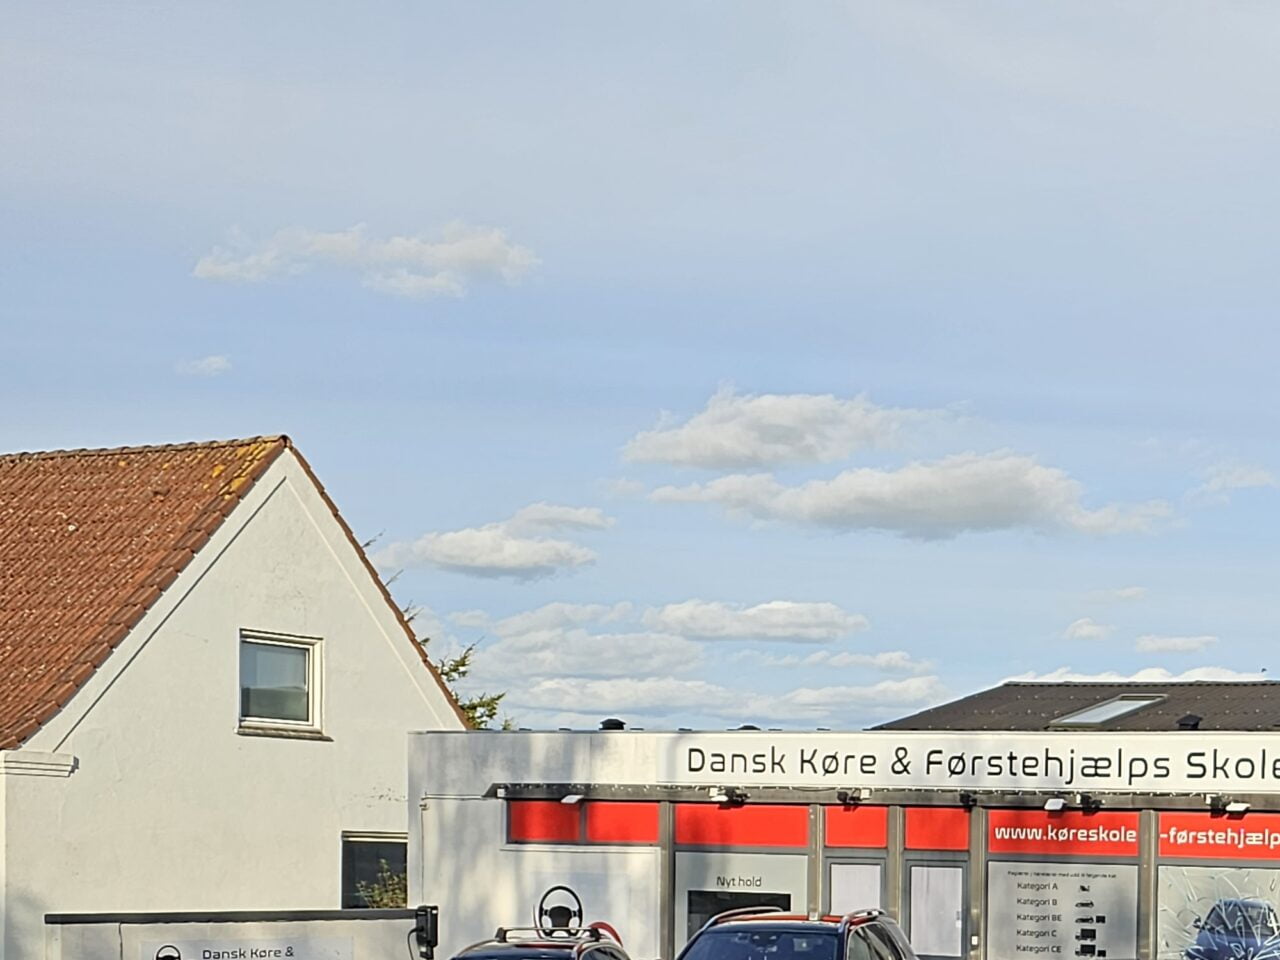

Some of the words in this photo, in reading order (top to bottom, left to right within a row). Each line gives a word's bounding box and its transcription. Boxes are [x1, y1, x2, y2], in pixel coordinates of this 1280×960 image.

[688, 746, 786, 773] Dansk
[800, 749, 877, 777] Køre
[890, 747, 911, 775] &
[926, 748, 1170, 786] Førstehjælps
[994, 825, 1137, 843] www.køreskole
[717, 876, 736, 888] Nyt
[738, 875, 762, 887] hold
[1017, 883, 1050, 891] Kategori
[1017, 898, 1050, 907] Kategori
[1016, 914, 1050, 922] Kategori
[1052, 914, 1062, 922] BE
[1016, 929, 1050, 938] Kategori
[202, 948, 246, 960] Dansk
[250, 947, 282, 959] Køre
[285, 946, 295, 957] &
[1016, 945, 1049, 953] Kategori
